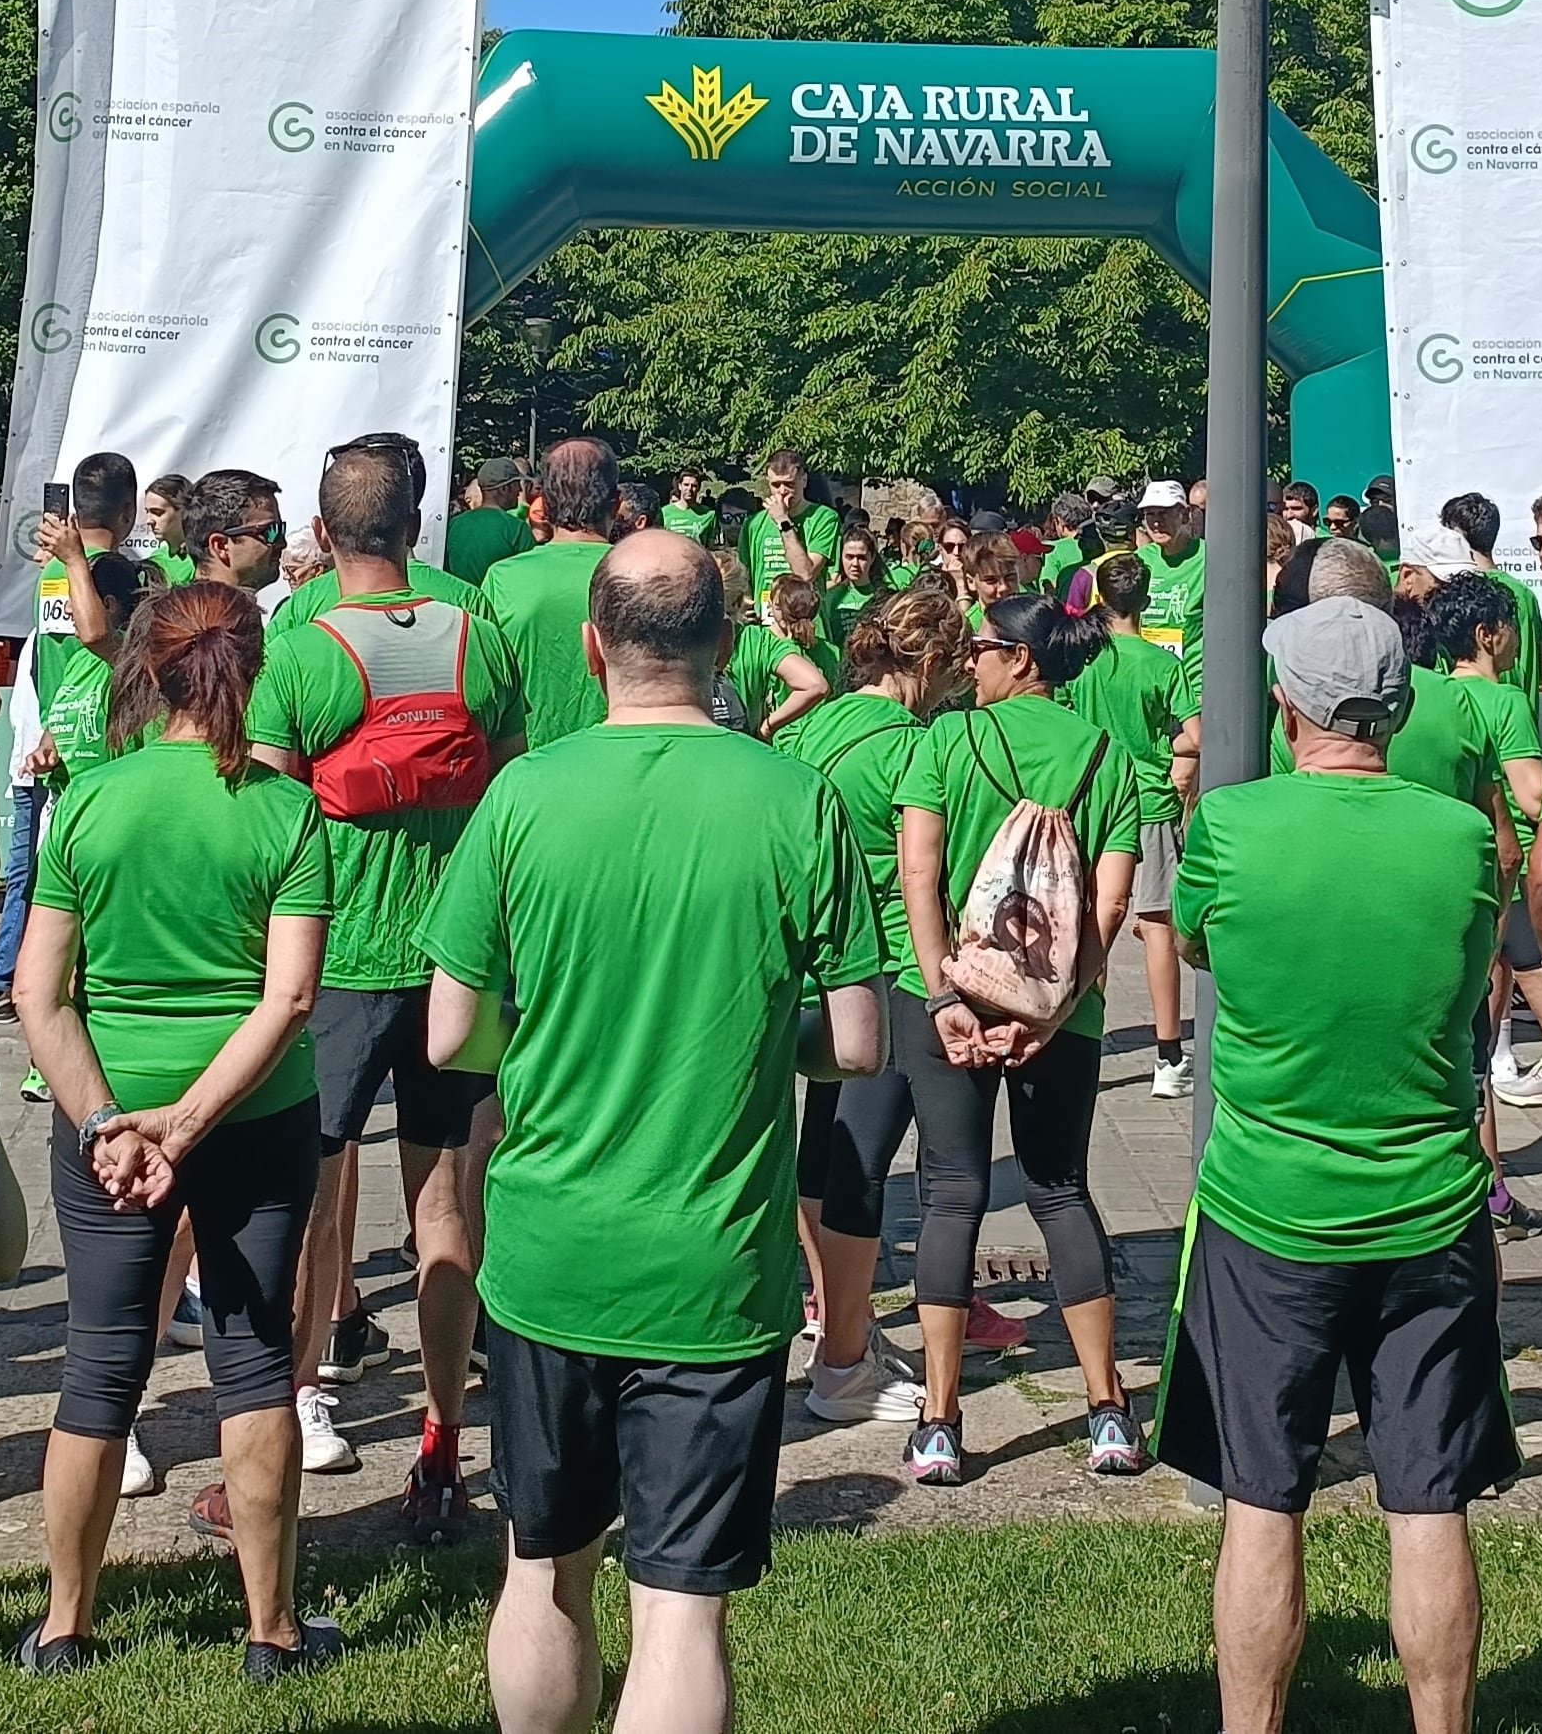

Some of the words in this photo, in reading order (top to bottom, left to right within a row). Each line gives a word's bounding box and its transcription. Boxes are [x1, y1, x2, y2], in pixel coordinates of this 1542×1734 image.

[161, 100, 220, 114] española
[790, 82, 913, 124] CAJA
[922, 85, 1089, 123] RURAL
[93, 114, 132, 125] contra
[135, 114, 145, 125] el
[148, 115, 192, 128] cáncer
[325, 109, 393, 124] asociación
[396, 110, 455, 127] española
[111, 128, 159, 142] Navarra
[324, 123, 365, 138] contra
[368, 124, 381, 138] el
[384, 123, 427, 139] cáncer
[1466, 127, 1534, 141] asociación
[324, 140, 340, 152] en
[343, 139, 395, 154] Navarra
[789, 125, 859, 164] DE
[873, 126, 1111, 167] NAVARRA
[1466, 142, 1509, 156] contra
[1511, 142, 1523, 155] el
[1467, 160, 1484, 170] en
[1487, 157, 1538, 170] Navarra
[896, 176, 996, 198] ACCIÓN
[1010, 179, 1108, 198] SOCIAL
[148, 314, 208, 328] española
[82, 325, 119, 337] contra
[122, 326, 132, 338] el
[135, 327, 180, 341] cáncer
[311, 319, 378, 334] asociación
[381, 321, 442, 338] española
[99, 340, 146, 354] Navarra
[310, 334, 350, 349] contra
[354, 335, 367, 349] el
[370, 334, 413, 350] cáncer
[1472, 336, 1542, 350] asociación
[309, 352, 326, 363] en
[329, 349, 379, 364] Navarra
[1473, 351, 1515, 365] contra
[1518, 351, 1530, 365] el
[1473, 370, 1490, 380] en
[1525, 561, 1537, 572] el
[386, 709, 445, 725] AONIJIE
